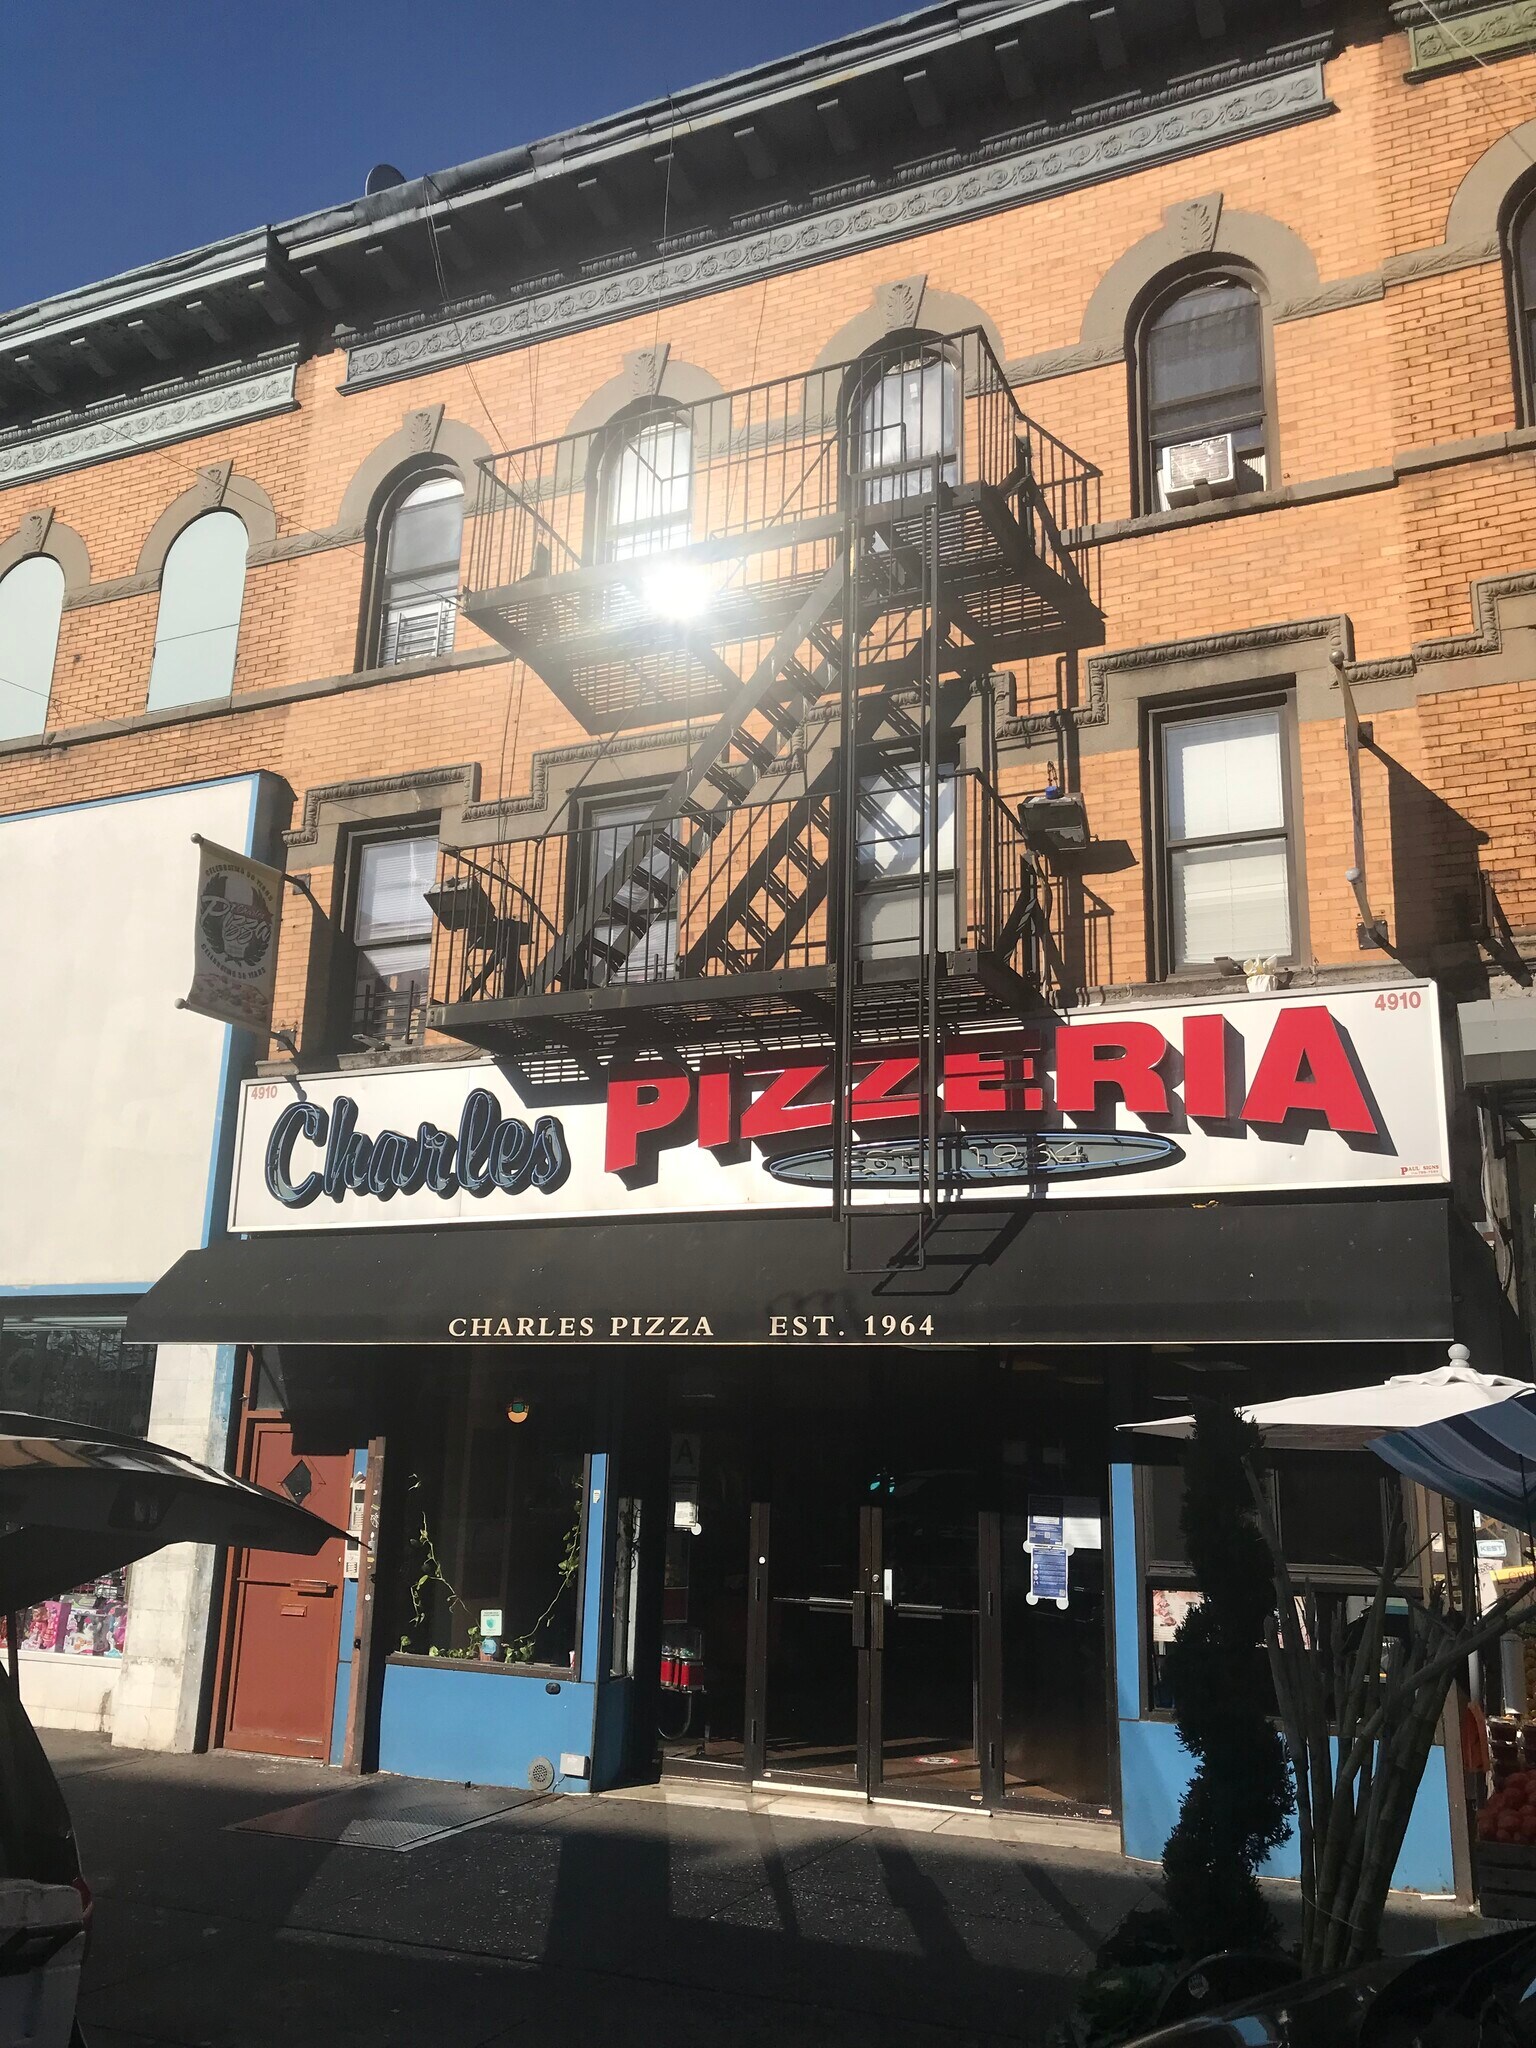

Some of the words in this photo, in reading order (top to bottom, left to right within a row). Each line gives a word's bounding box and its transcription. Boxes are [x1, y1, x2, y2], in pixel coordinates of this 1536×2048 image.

[200, 894, 273, 945] Pizza
[248, 966, 267, 979] YEARS
[1374, 991, 1422, 1011] 4910
[251, 1085, 278, 1100] 4910
[265, 1087, 572, 1210] Charles
[604, 1004, 1379, 1174] PIZZERIA
[1400, 1165, 1420, 1176] PAUL
[448, 1316, 595, 1338] CHARLES
[610, 1316, 715, 1338] PIZZA
[769, 1315, 846, 1337] EST.
[864, 1313, 935, 1337] 1964
